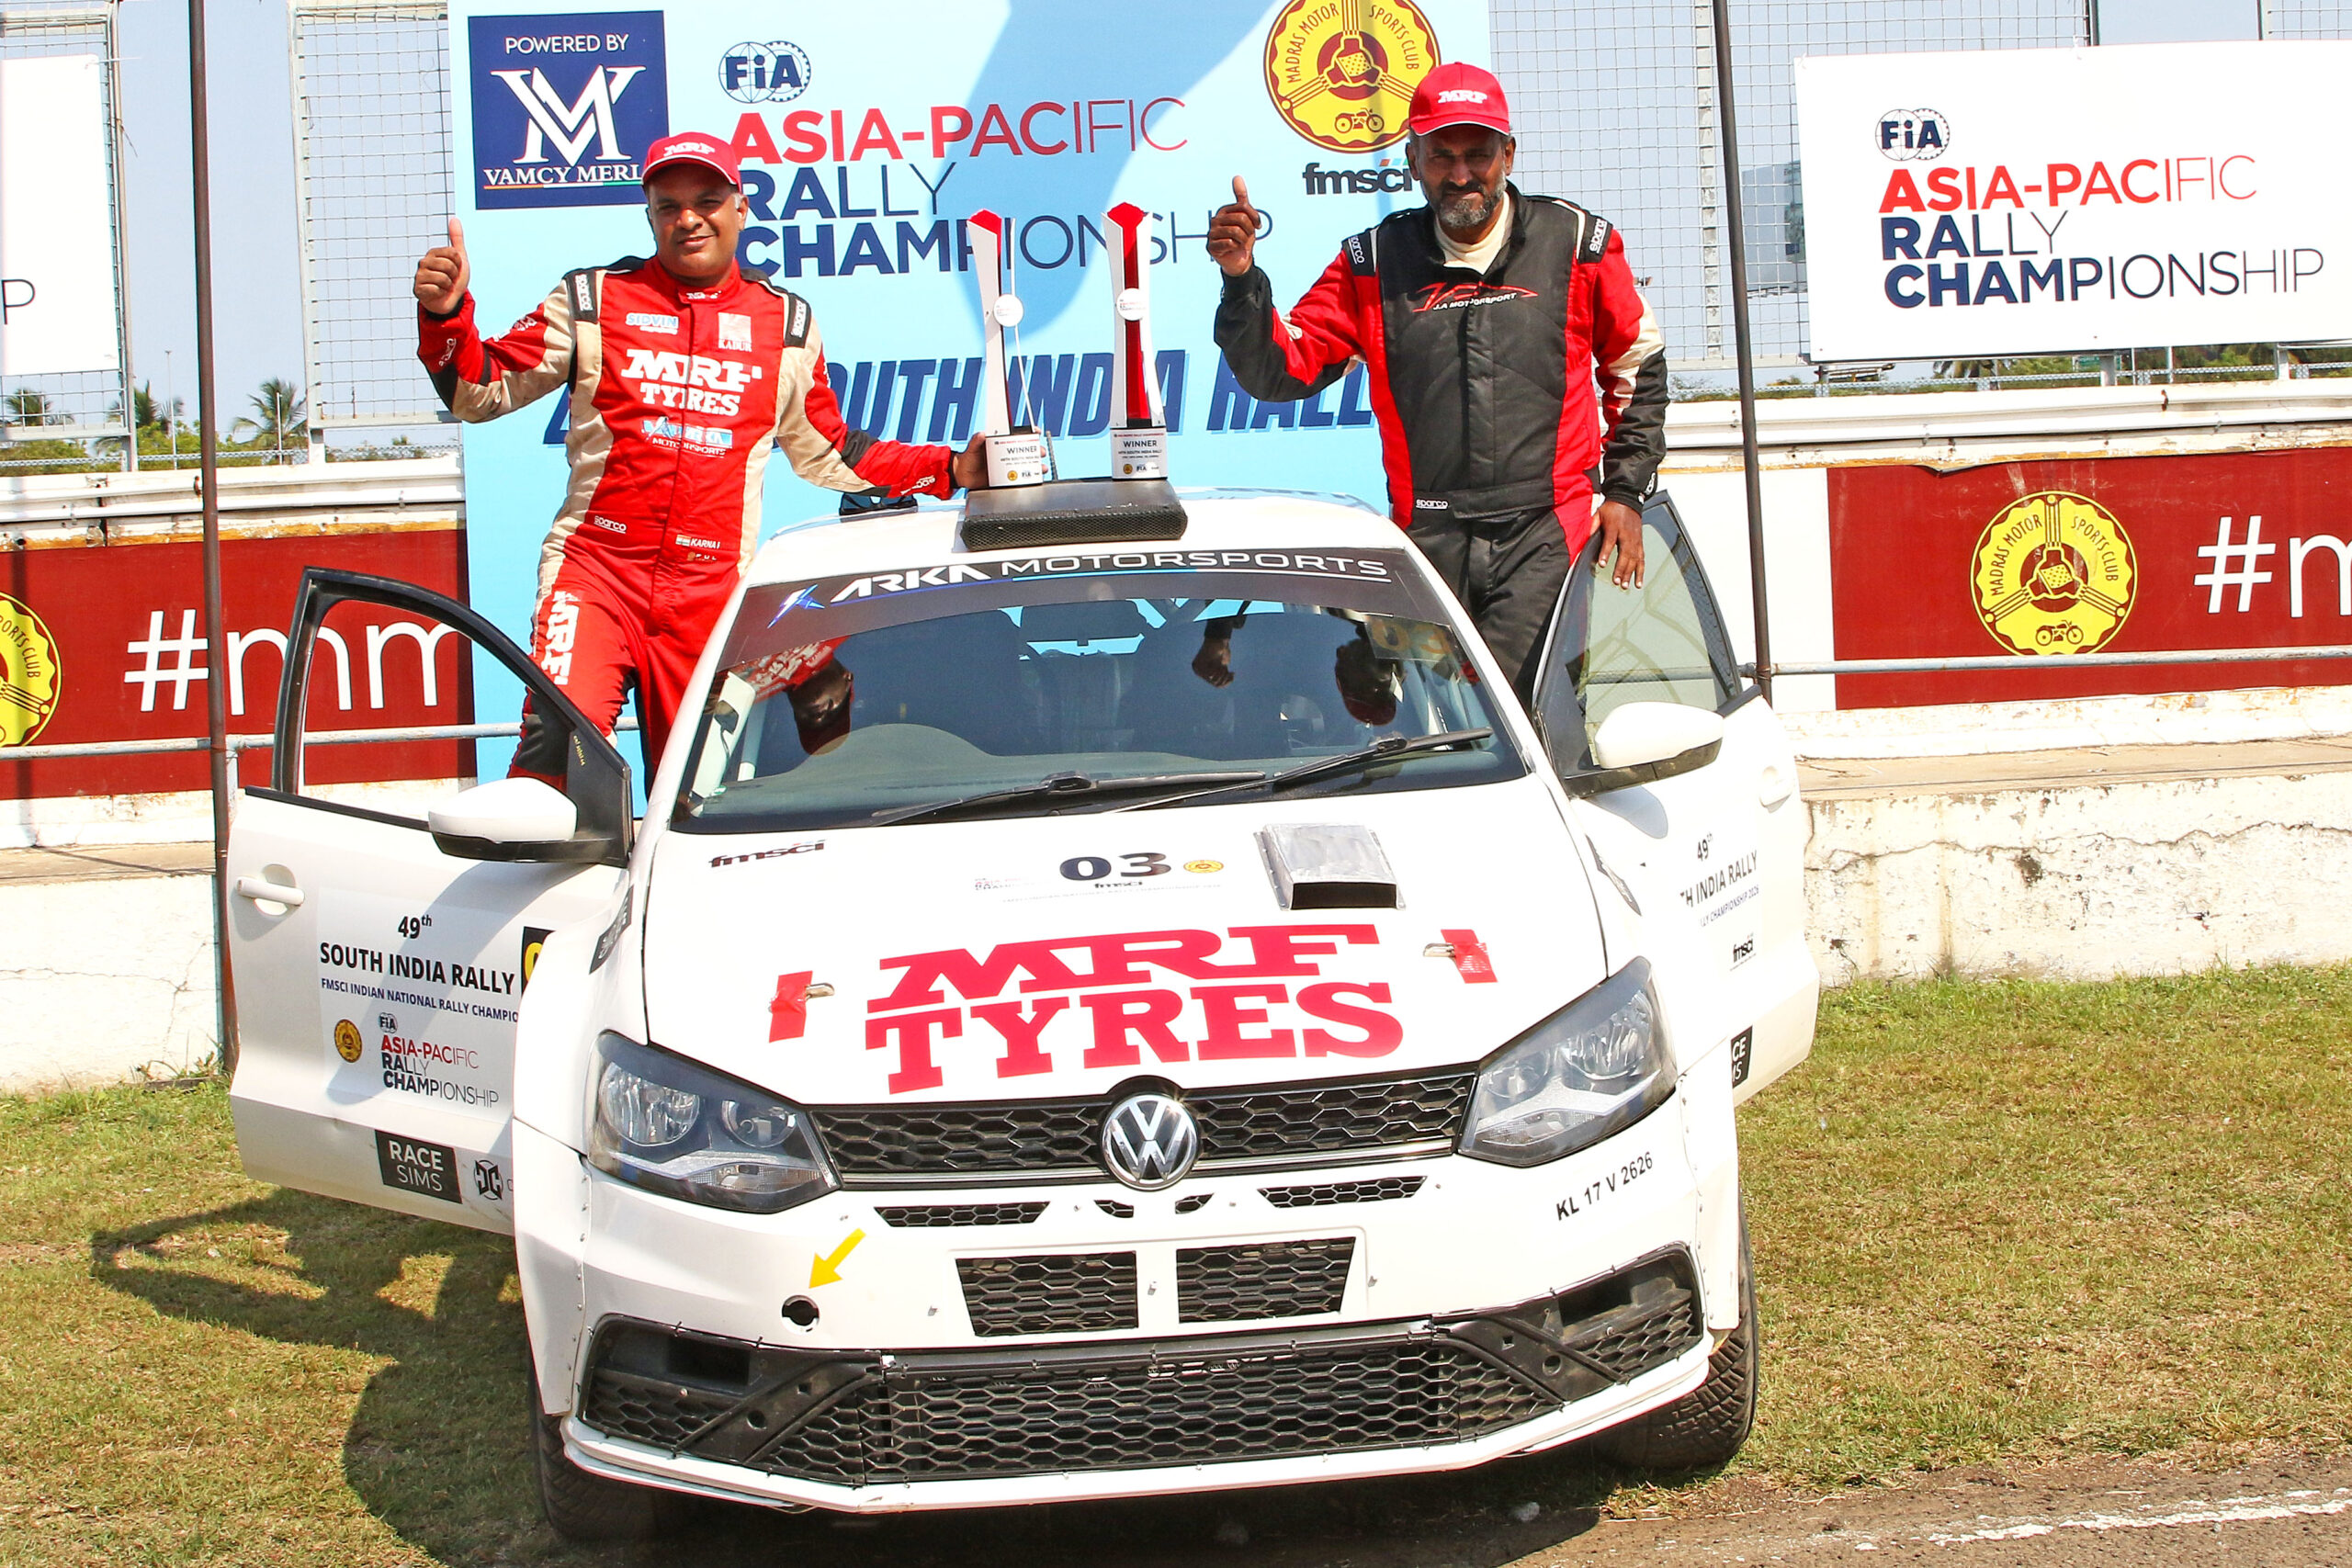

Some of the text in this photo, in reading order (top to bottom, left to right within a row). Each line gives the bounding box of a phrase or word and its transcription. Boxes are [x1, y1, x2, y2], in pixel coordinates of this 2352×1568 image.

[505, 33, 629, 54] POWERED BY
[1285, 3, 1419, 84] MADRAS MOTOR SPORTS CLUB
[1438, 89, 1488, 104] MRF
[729, 96, 1188, 165] ASIA-PACIFIC
[483, 166, 572, 186] VAMCY
[738, 162, 957, 221] RALLY
[1302, 162, 1413, 196] fmsci
[1878, 154, 2257, 214] ASIA-PACIFIC
[1880, 210, 2068, 261] RALLY
[1883, 247, 2324, 310] CHAMPIONSHIP
[626, 313, 678, 329] SIDVIN
[621, 348, 762, 393] MRF
[639, 382, 741, 416] TYRES
[594, 515, 628, 534] sparco
[1001, 551, 1389, 578] MOTORSPORTS
[1989, 514, 2119, 596] MADRAS MOTOR SPORTS CLUB
[22, 647, 41, 678] CLUB
[1059, 852, 1171, 881] 03
[1695, 869, 1726, 905] INDIA
[1727, 849, 1758, 886] RALLY
[1710, 890, 1748, 922] CHAMPIONSHIP
[398, 915, 433, 939] 49th
[321, 942, 515, 995] SOUTH INDIA RALLY
[865, 923, 1378, 1014] MRF
[321, 977, 349, 994] FMSCI
[350, 983, 385, 999] INDIAN
[387, 989, 437, 1010] NATIONAL
[438, 998, 469, 1015] RALLY
[380, 1033, 480, 1070] ASIA-PACIFIC
[865, 982, 1404, 1095] TYRES
[380, 1052, 430, 1077] RALLY
[383, 1070, 500, 1109] CHAMPIONSHIP
[389, 1140, 444, 1172] RACE
[396, 1164, 443, 1192] SIMS
[1555, 1151, 1653, 1222] KL 17 V 2626
